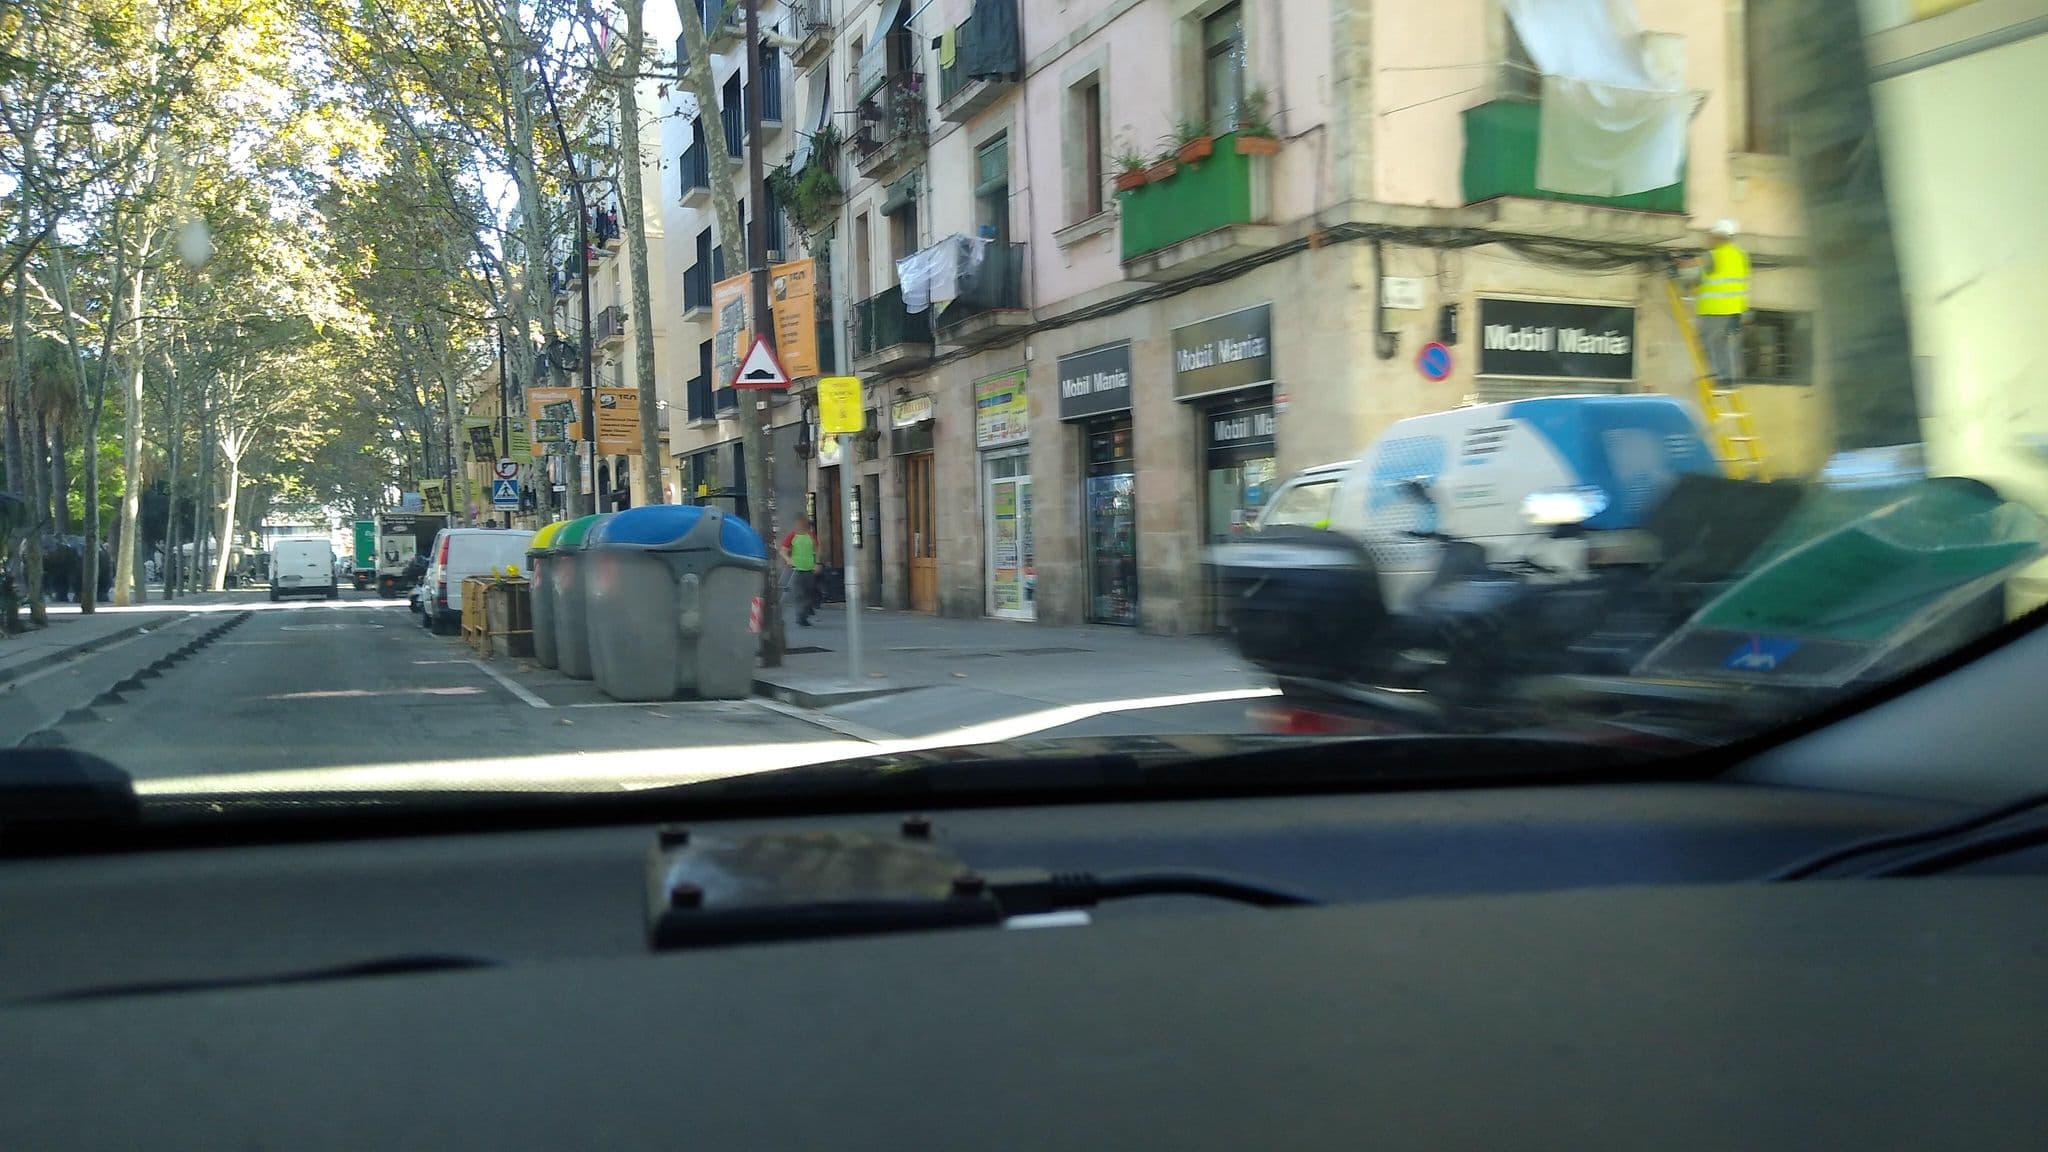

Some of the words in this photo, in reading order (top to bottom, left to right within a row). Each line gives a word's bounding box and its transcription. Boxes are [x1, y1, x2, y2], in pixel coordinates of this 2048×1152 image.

[1176, 343, 1215, 373] Mobil
[1217, 334, 1266, 363] Mania
[1485, 324, 1556, 351] Mobil
[1557, 328, 1632, 355] Mania
[1062, 375, 1092, 399] Mobil
[1093, 368, 1129, 393] Mania
[1214, 416, 1252, 441] Mobil
